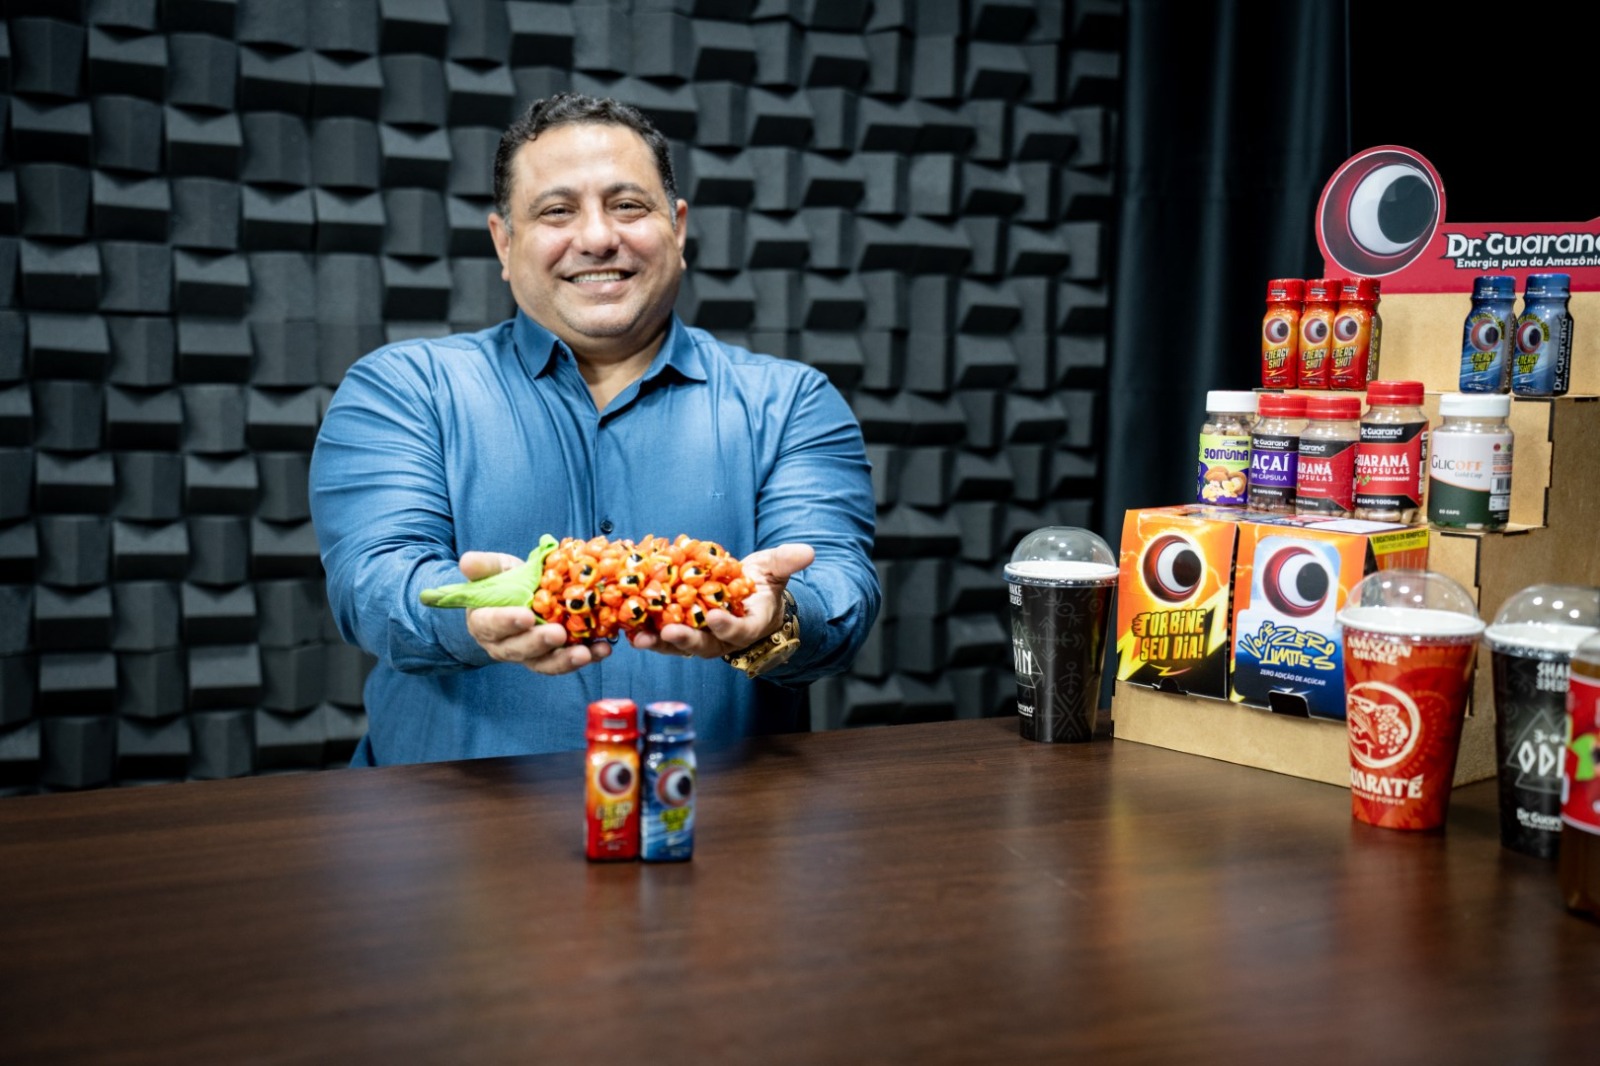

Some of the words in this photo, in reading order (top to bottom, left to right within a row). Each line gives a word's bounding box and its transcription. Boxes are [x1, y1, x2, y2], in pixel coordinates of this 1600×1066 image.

[1446, 233, 1482, 258] Dr.
[1486, 232, 1600, 256] Guaran
[1457, 258, 1499, 270] Energia
[1501, 258, 1528, 270] pura
[1529, 257, 1543, 267] da
[1367, 426, 1403, 437] Guaraná
[1252, 452, 1290, 474] AÇAÍ
[1362, 466, 1411, 475] CAPSULAS
[1140, 636, 1169, 661] SEU
[1276, 626, 1335, 656] ZERO
[1259, 642, 1336, 670] LIMITES
[1260, 668, 1274, 677] ZERO
[1295, 674, 1304, 682] DE
[1518, 740, 1566, 778] ODI
[1351, 766, 1425, 799] UARATÉ
